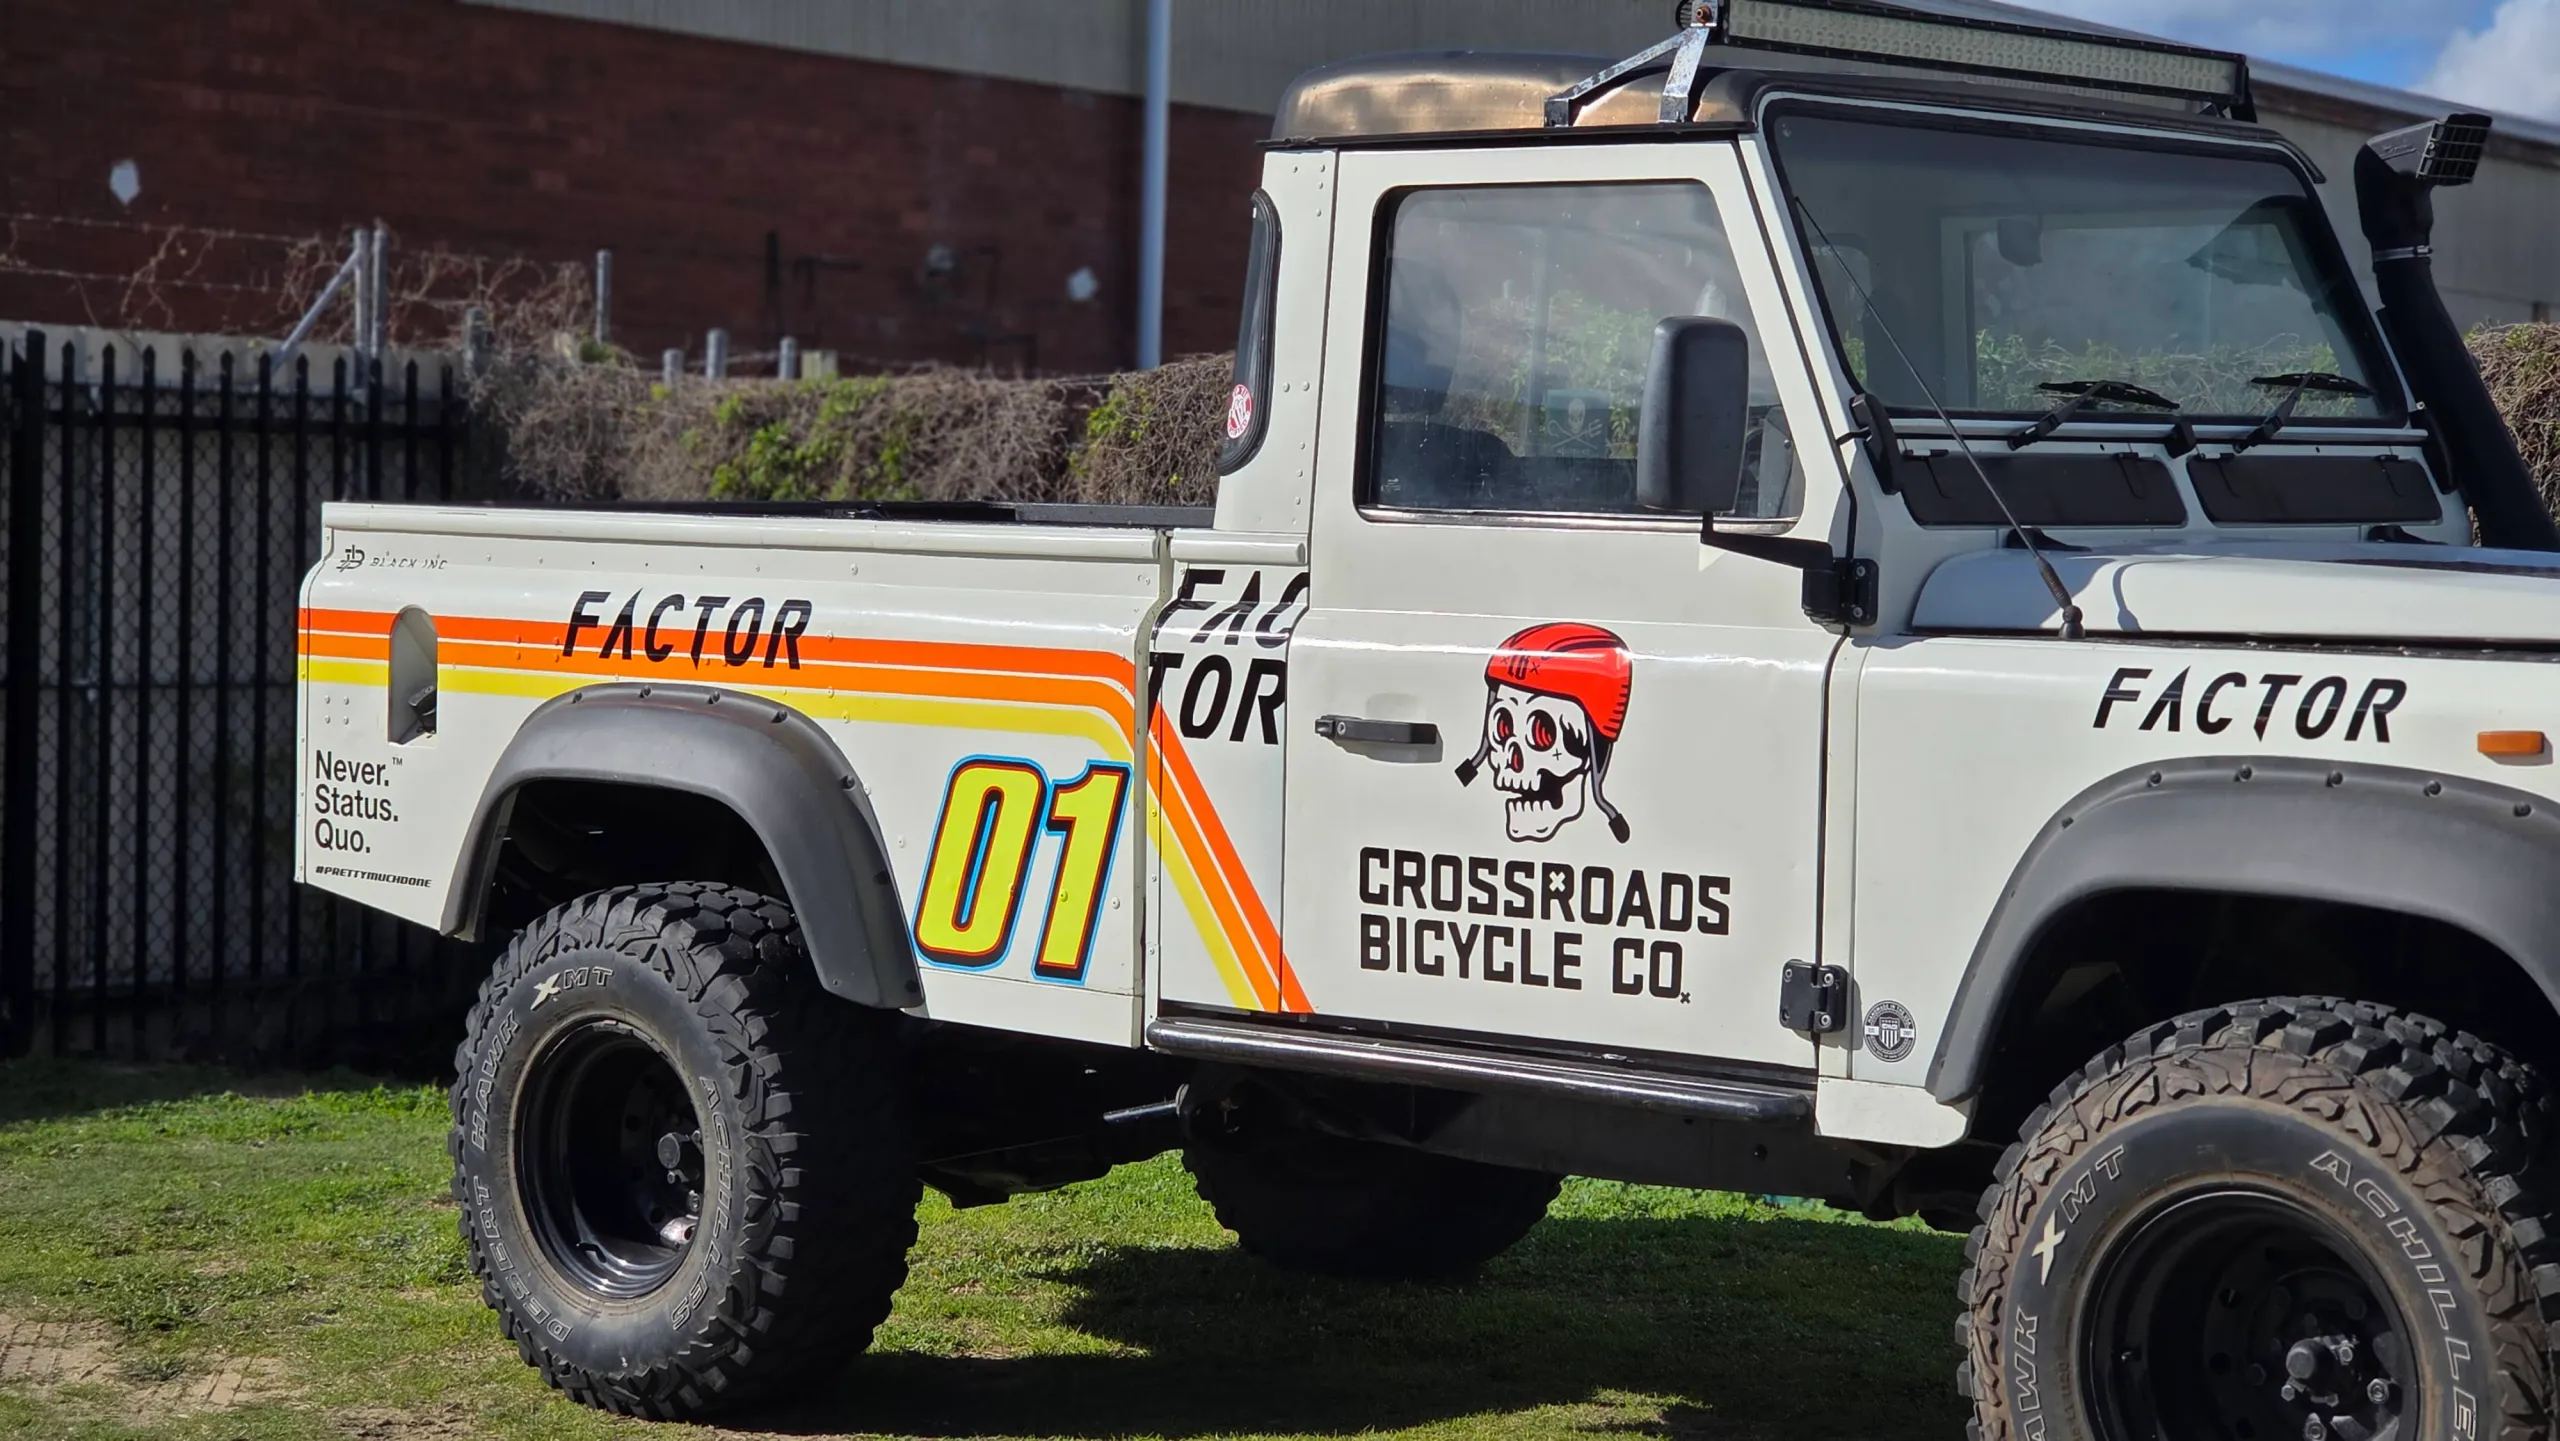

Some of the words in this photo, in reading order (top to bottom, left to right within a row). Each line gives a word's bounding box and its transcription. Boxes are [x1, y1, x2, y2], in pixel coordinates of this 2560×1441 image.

[369, 557, 417, 568] BLACK
[421, 559, 448, 569] INC
[562, 587, 812, 671] FACTOR
[1147, 652, 1287, 745] TOR
[2093, 666, 2407, 743] FACTOR
[315, 783, 398, 822] Status.
[315, 818, 371, 854] Quo.
[315, 866, 432, 888] #PRETTYMUCHDONE
[912, 753, 1133, 986] 01
[1359, 846, 1731, 935] CROSSROADS
[1360, 913, 1582, 990] BICYCLE
[472, 1005, 520, 1152] HAWK
[671, 1076, 733, 1331] ACHILLES
[473, 1175, 572, 1342] DESERT
[2309, 1150, 2477, 1441] ACHILLE
